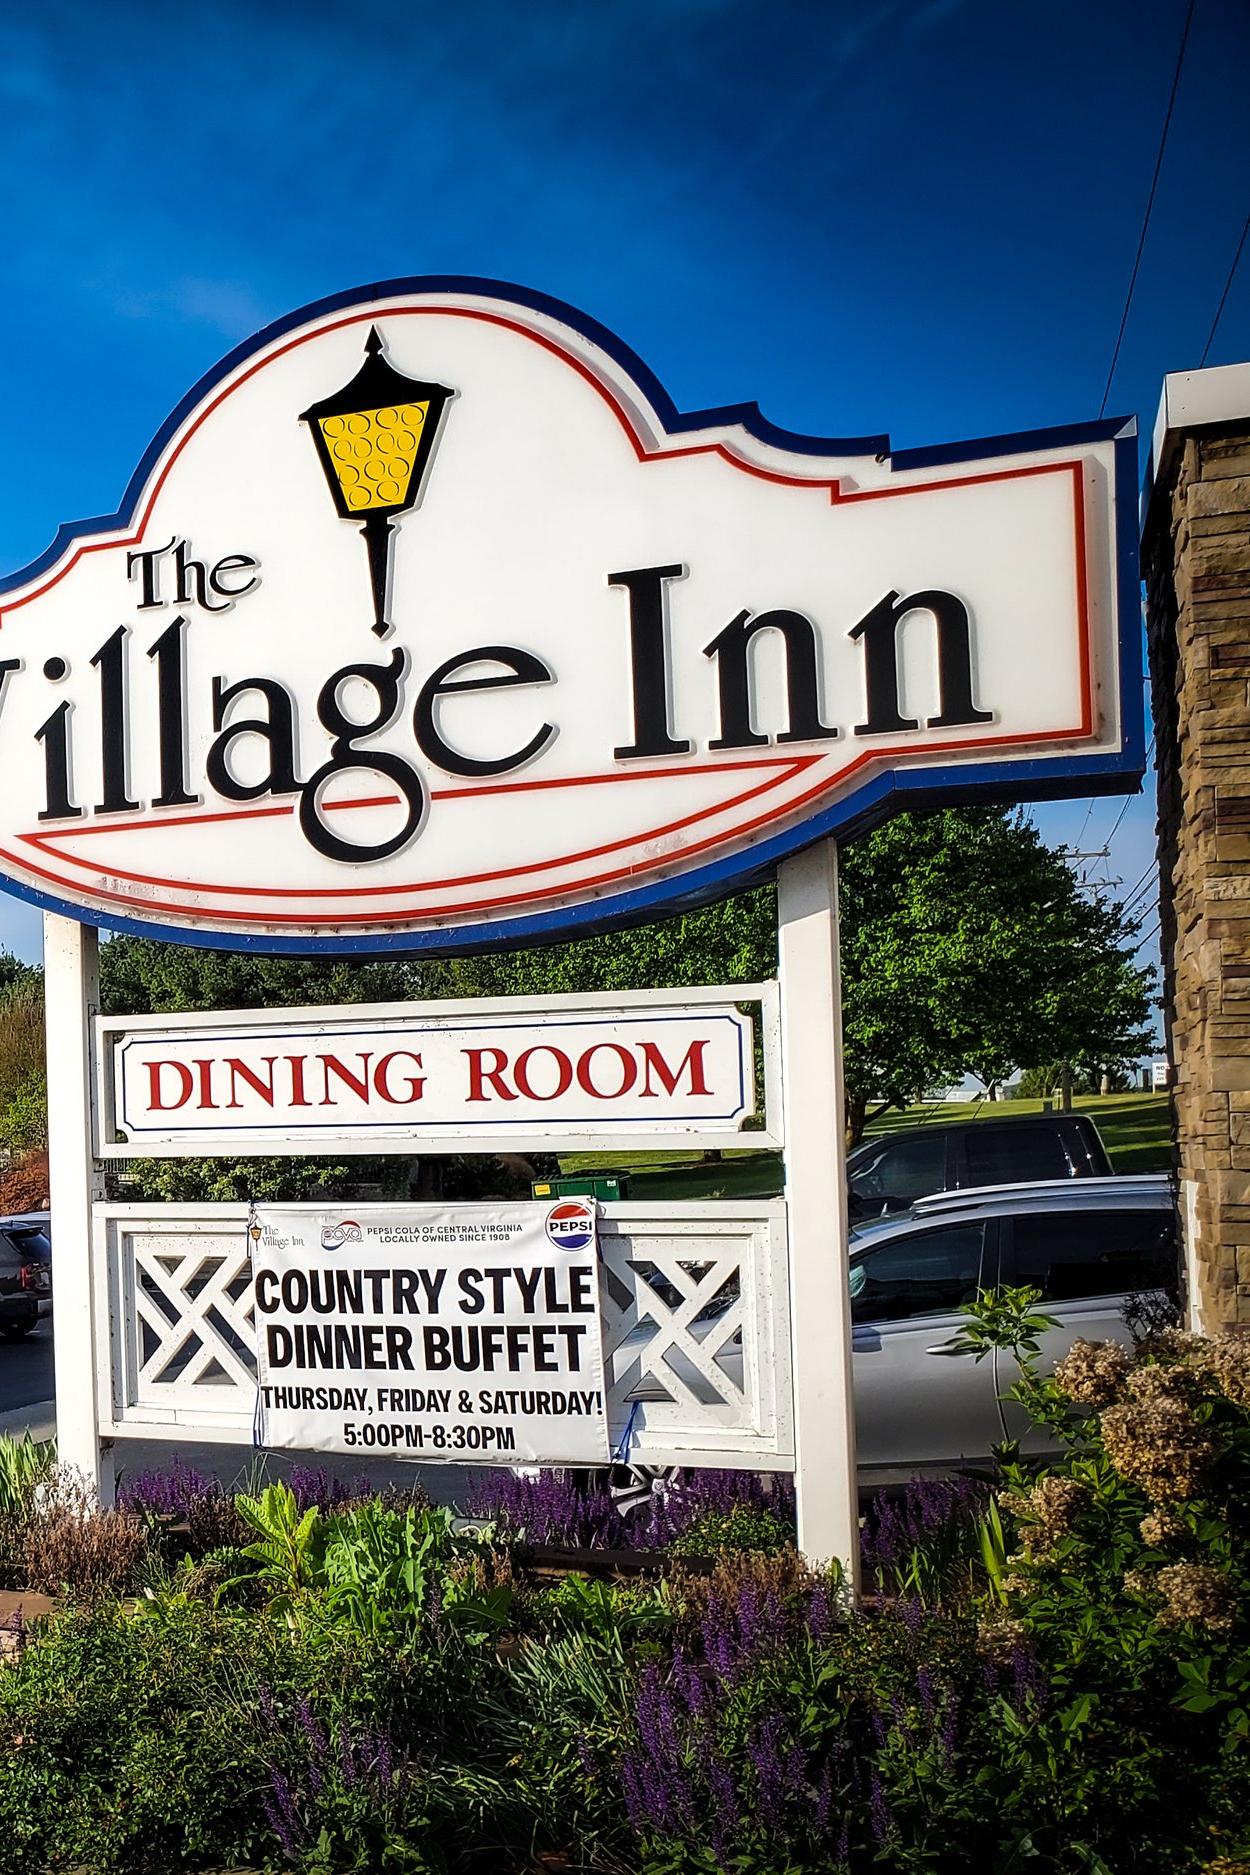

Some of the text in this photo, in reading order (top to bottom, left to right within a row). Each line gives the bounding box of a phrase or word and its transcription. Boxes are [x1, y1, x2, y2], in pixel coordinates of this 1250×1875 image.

[127, 536, 256, 611] The
[607, 563, 994, 760] Inn
[142, 1040, 715, 1111] DINING ROOM
[262, 1225, 279, 1236] The
[367, 1224, 523, 1235] PEPSI COLA OF CENTRAL VIRGINIA
[379, 1233, 510, 1243] LOCALLY OWNED SINCE 1908
[550, 1221, 593, 1232] PEPSI
[262, 1235, 305, 1250] Village Inn
[254, 1266, 596, 1315] COUNTRY STYLE
[266, 1324, 587, 1372] DINNER BUFFET
[261, 1386, 604, 1416] THURSDAY, FRIDAY & SATURDAY!
[344, 1423, 516, 1450] 5:00PM-8:30PM
